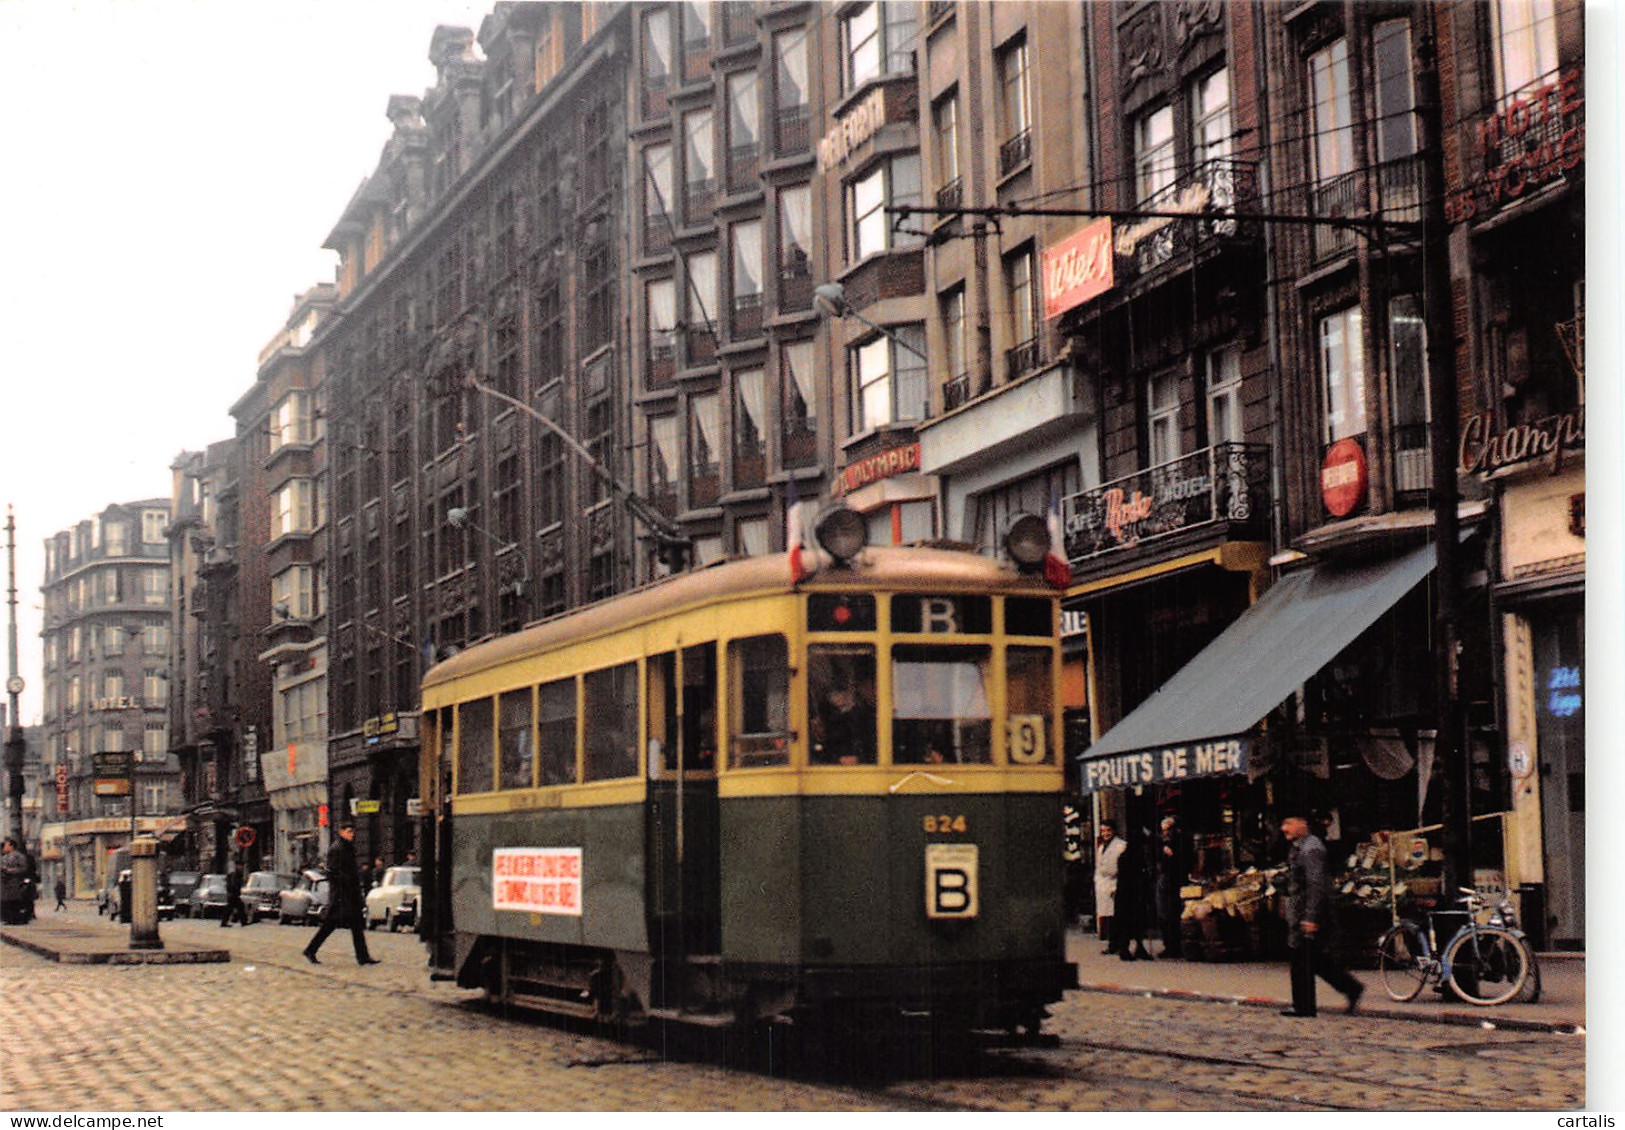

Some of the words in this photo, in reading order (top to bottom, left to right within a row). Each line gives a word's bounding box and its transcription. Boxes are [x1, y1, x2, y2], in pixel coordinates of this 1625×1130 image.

[922, 600, 957, 634] B
[1087, 753, 1153, 789] FRUITS
[1162, 748, 1188, 779] DE
[1195, 741, 1242, 774] MER
[923, 815, 967, 833] 824
[936, 869, 971, 913] B
